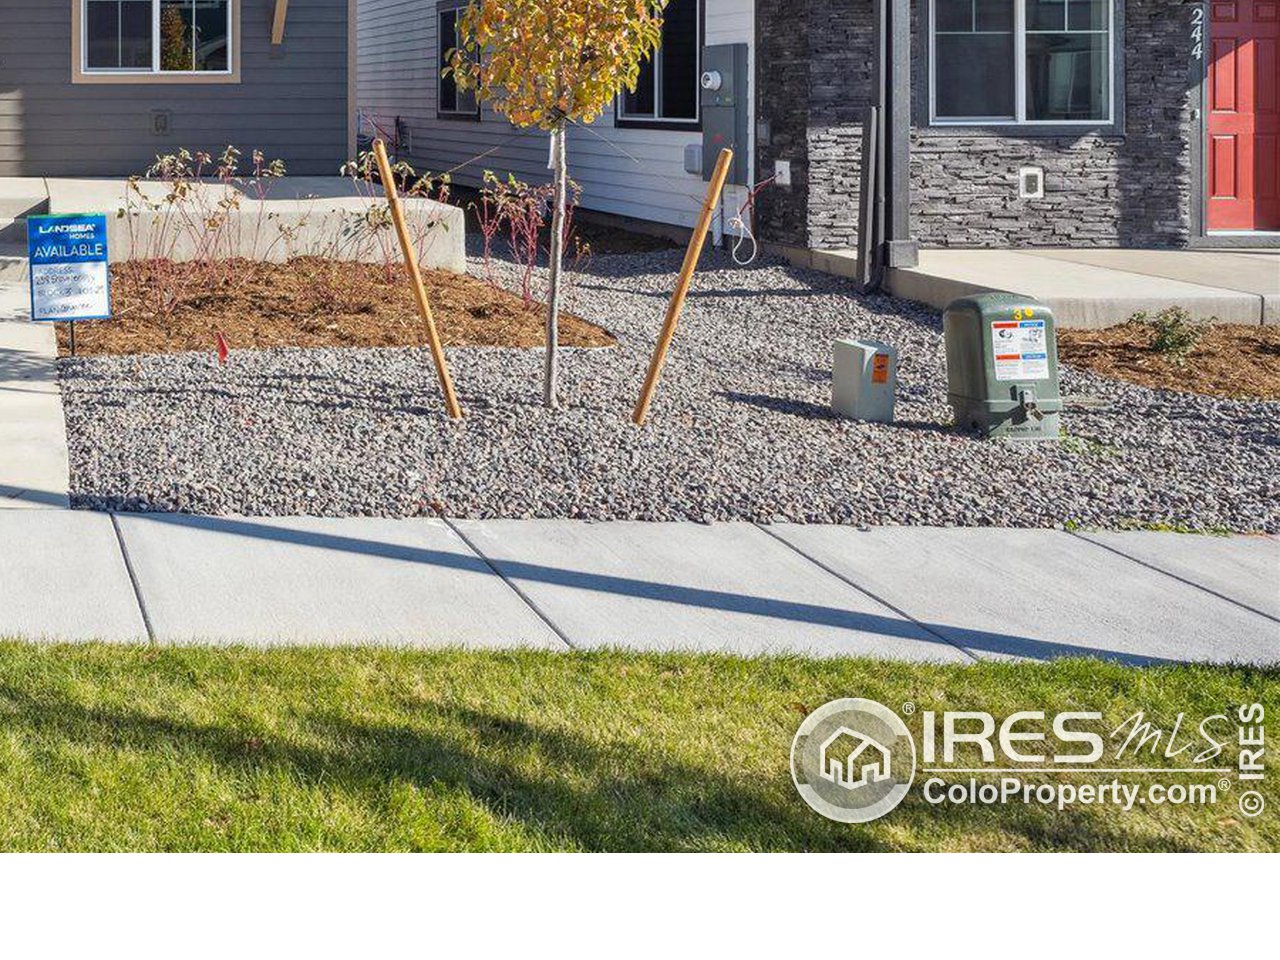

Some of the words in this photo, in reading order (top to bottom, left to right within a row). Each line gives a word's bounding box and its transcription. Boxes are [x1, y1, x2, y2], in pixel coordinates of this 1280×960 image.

[1191, 8, 1203, 60] 244
[69, 232, 96, 240] HOMES
[34, 243, 104, 258] AVAILABLE
